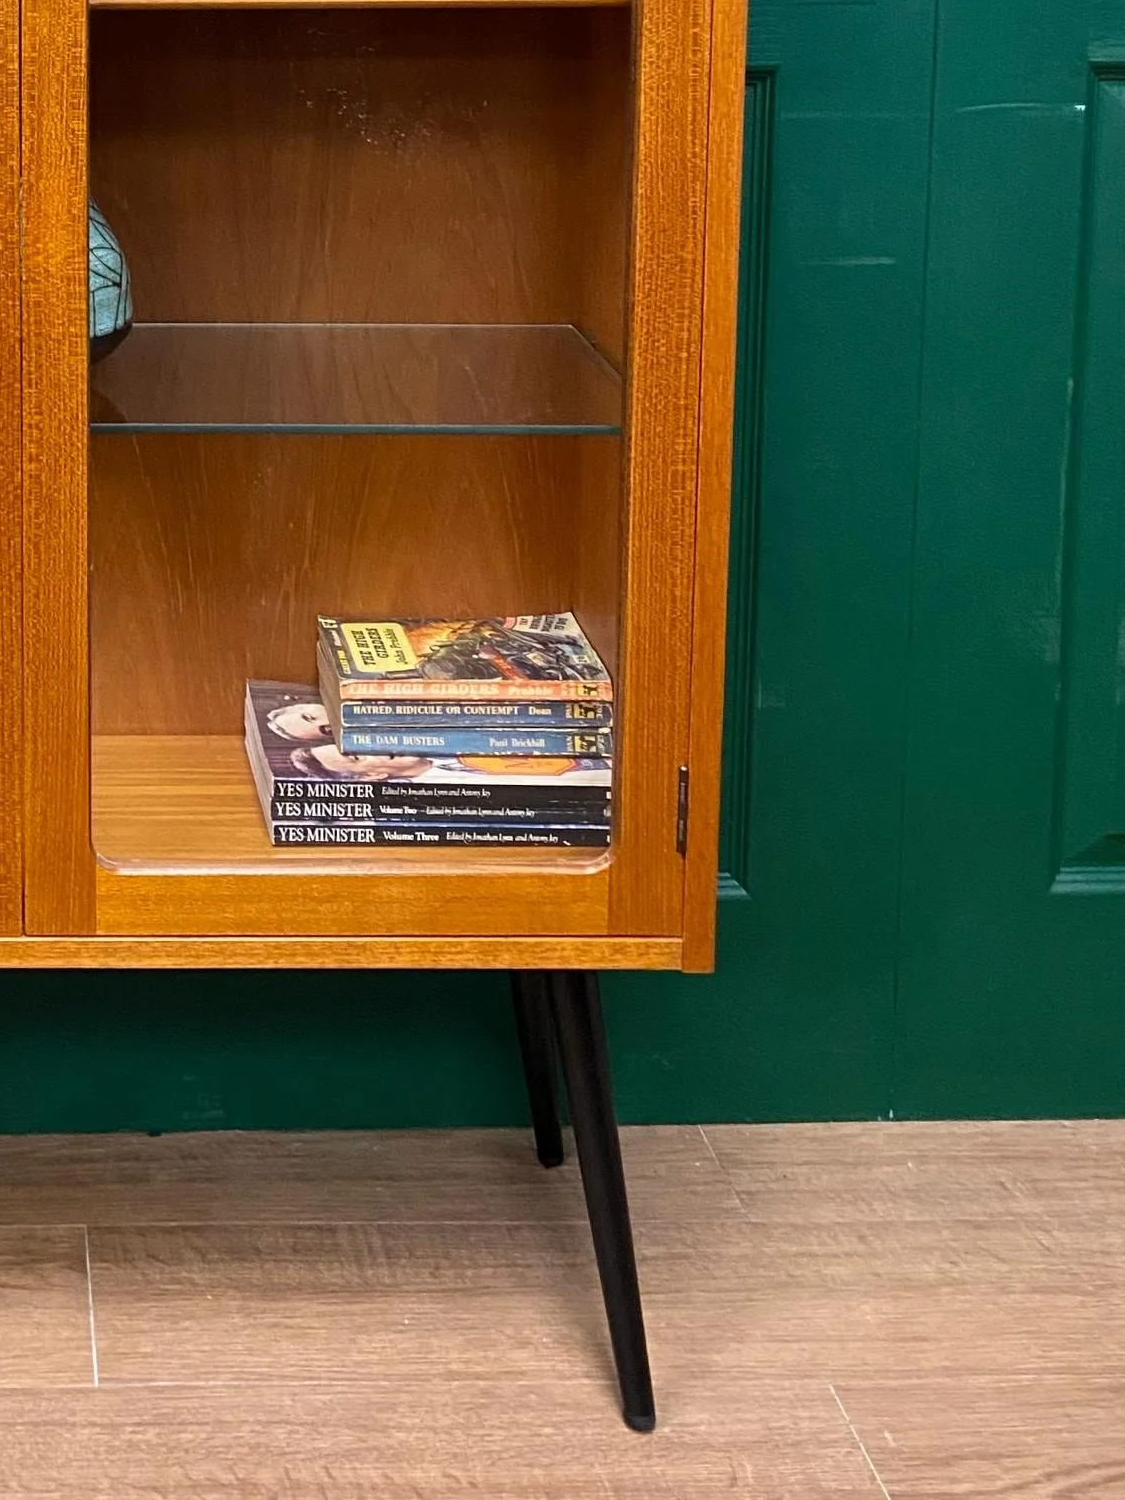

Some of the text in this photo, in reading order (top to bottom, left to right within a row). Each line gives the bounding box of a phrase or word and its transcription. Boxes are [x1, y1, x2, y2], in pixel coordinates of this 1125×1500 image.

[351, 630, 376, 665] THE HIGH
[366, 628, 389, 658] GIRDERS
[347, 684, 377, 695] THE
[384, 684, 424, 695] HIGH
[430, 684, 500, 696] GIRDERS
[395, 705, 443, 715] RIDICULE
[446, 706, 460, 715] OR
[464, 706, 519, 715] CONTEMPT
[352, 735, 372, 745] THE
[376, 735, 398, 745] DAM
[403, 736, 445, 746] BUSTERS
[277, 783, 304, 797] YES
[307, 783, 375, 798] MINISTER
[275, 802, 301, 816] YES
[304, 803, 373, 817] MINISTER
[379, 805, 403, 814] Volume
[403, 806, 417, 814] Two
[278, 827, 304, 842] YES
[307, 828, 375, 843] MINISTER
[383, 831, 414, 840] Volume
[415, 832, 439, 841] Three
